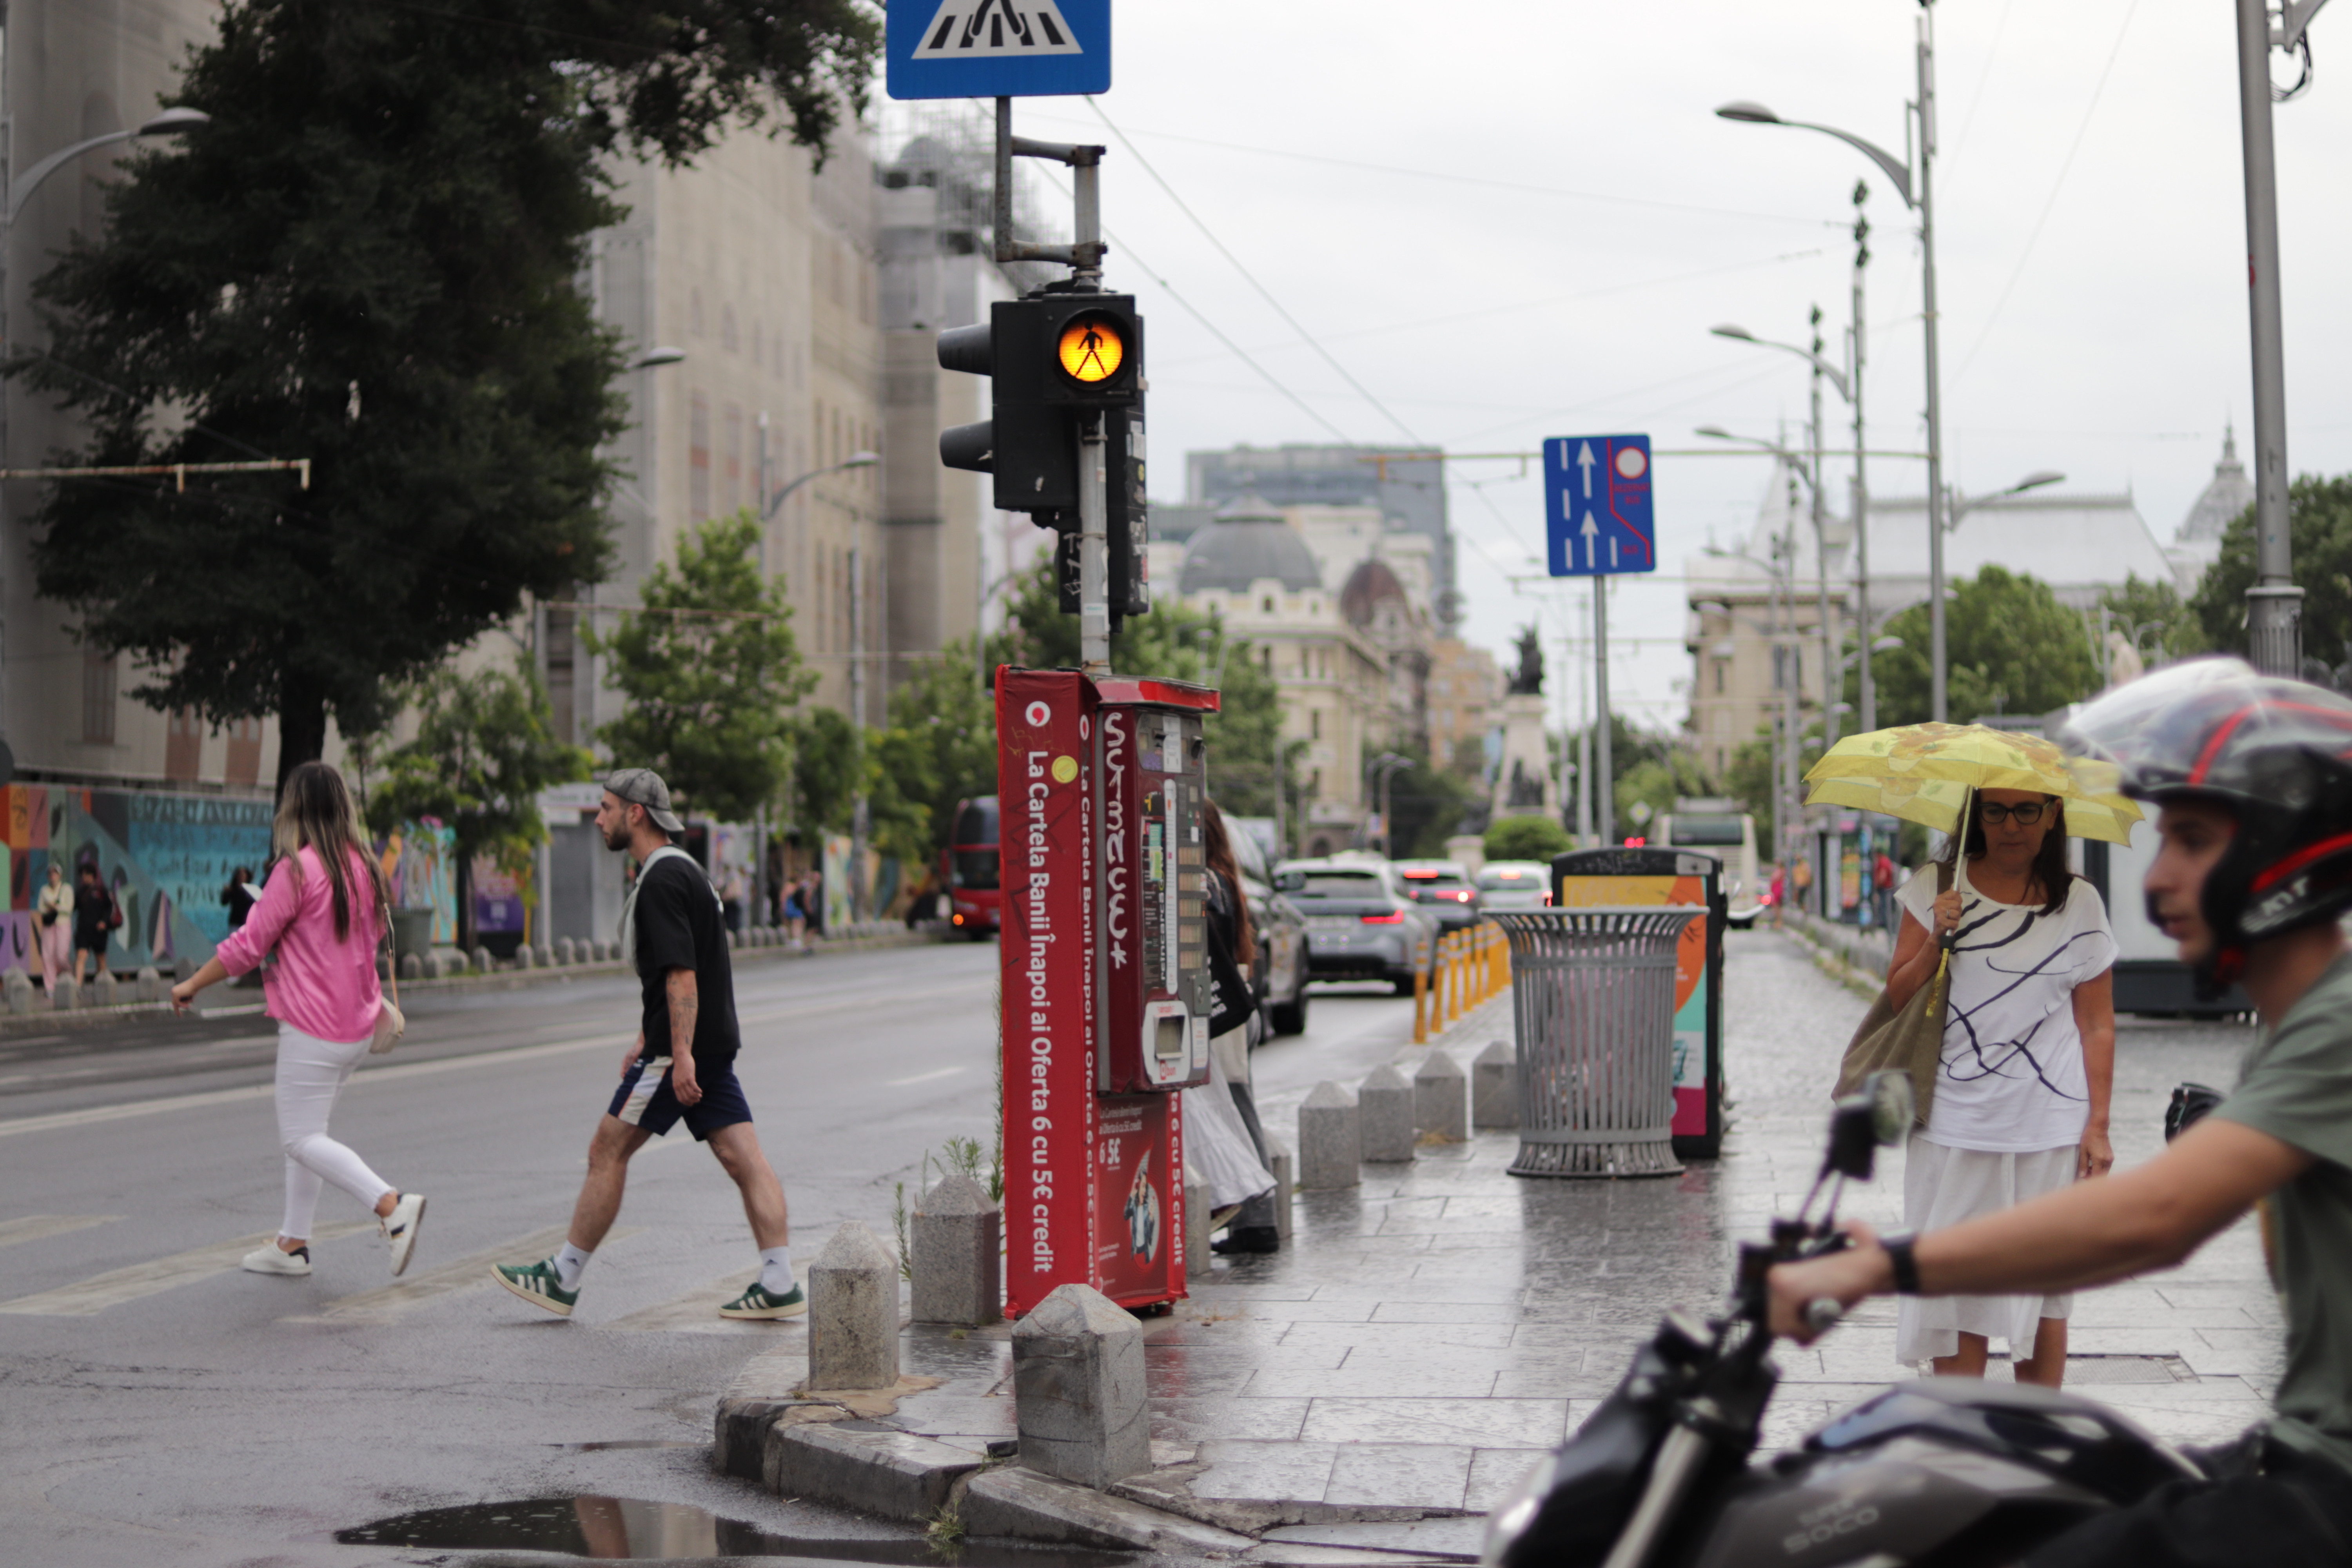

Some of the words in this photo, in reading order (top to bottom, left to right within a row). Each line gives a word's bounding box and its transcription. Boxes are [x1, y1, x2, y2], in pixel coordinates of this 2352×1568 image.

[1625, 496, 1641, 504] BUS
[1623, 545, 1638, 555] BUS
[1028, 751, 1048, 778] La
[1081, 766, 1089, 791] La
[1029, 782, 1049, 867] Cartela
[1082, 797, 1090, 880] Cartela
[1029, 873, 1050, 929] Banii
[1083, 887, 1092, 943] Banii
[1025, 933, 1056, 1007] Înapoi
[1083, 948, 1094, 1020] Înapoi
[1031, 1011, 1051, 1032] ai
[1085, 1026, 1093, 1045] ai
[1031, 1037, 1052, 1111] Oferta
[1032, 1116, 1053, 1131] 6
[1086, 1130, 1093, 1144] 6
[1171, 1118, 1180, 1131] 6
[1032, 1136, 1048, 1164] cu
[1099, 1142, 1105, 1163] 6
[1107, 1138, 1121, 1164] 5€
[1172, 1136, 1179, 1162] cu
[1087, 1149, 1093, 1178] cu
[1032, 1169, 1053, 1200] 5€
[1172, 1168, 1181, 1196] 5€
[1087, 1183, 1094, 1211] 5€
[1033, 1204, 1054, 1272] credit
[1173, 1201, 1183, 1265] credit
[1783, 1505, 1880, 1555] SOCO
